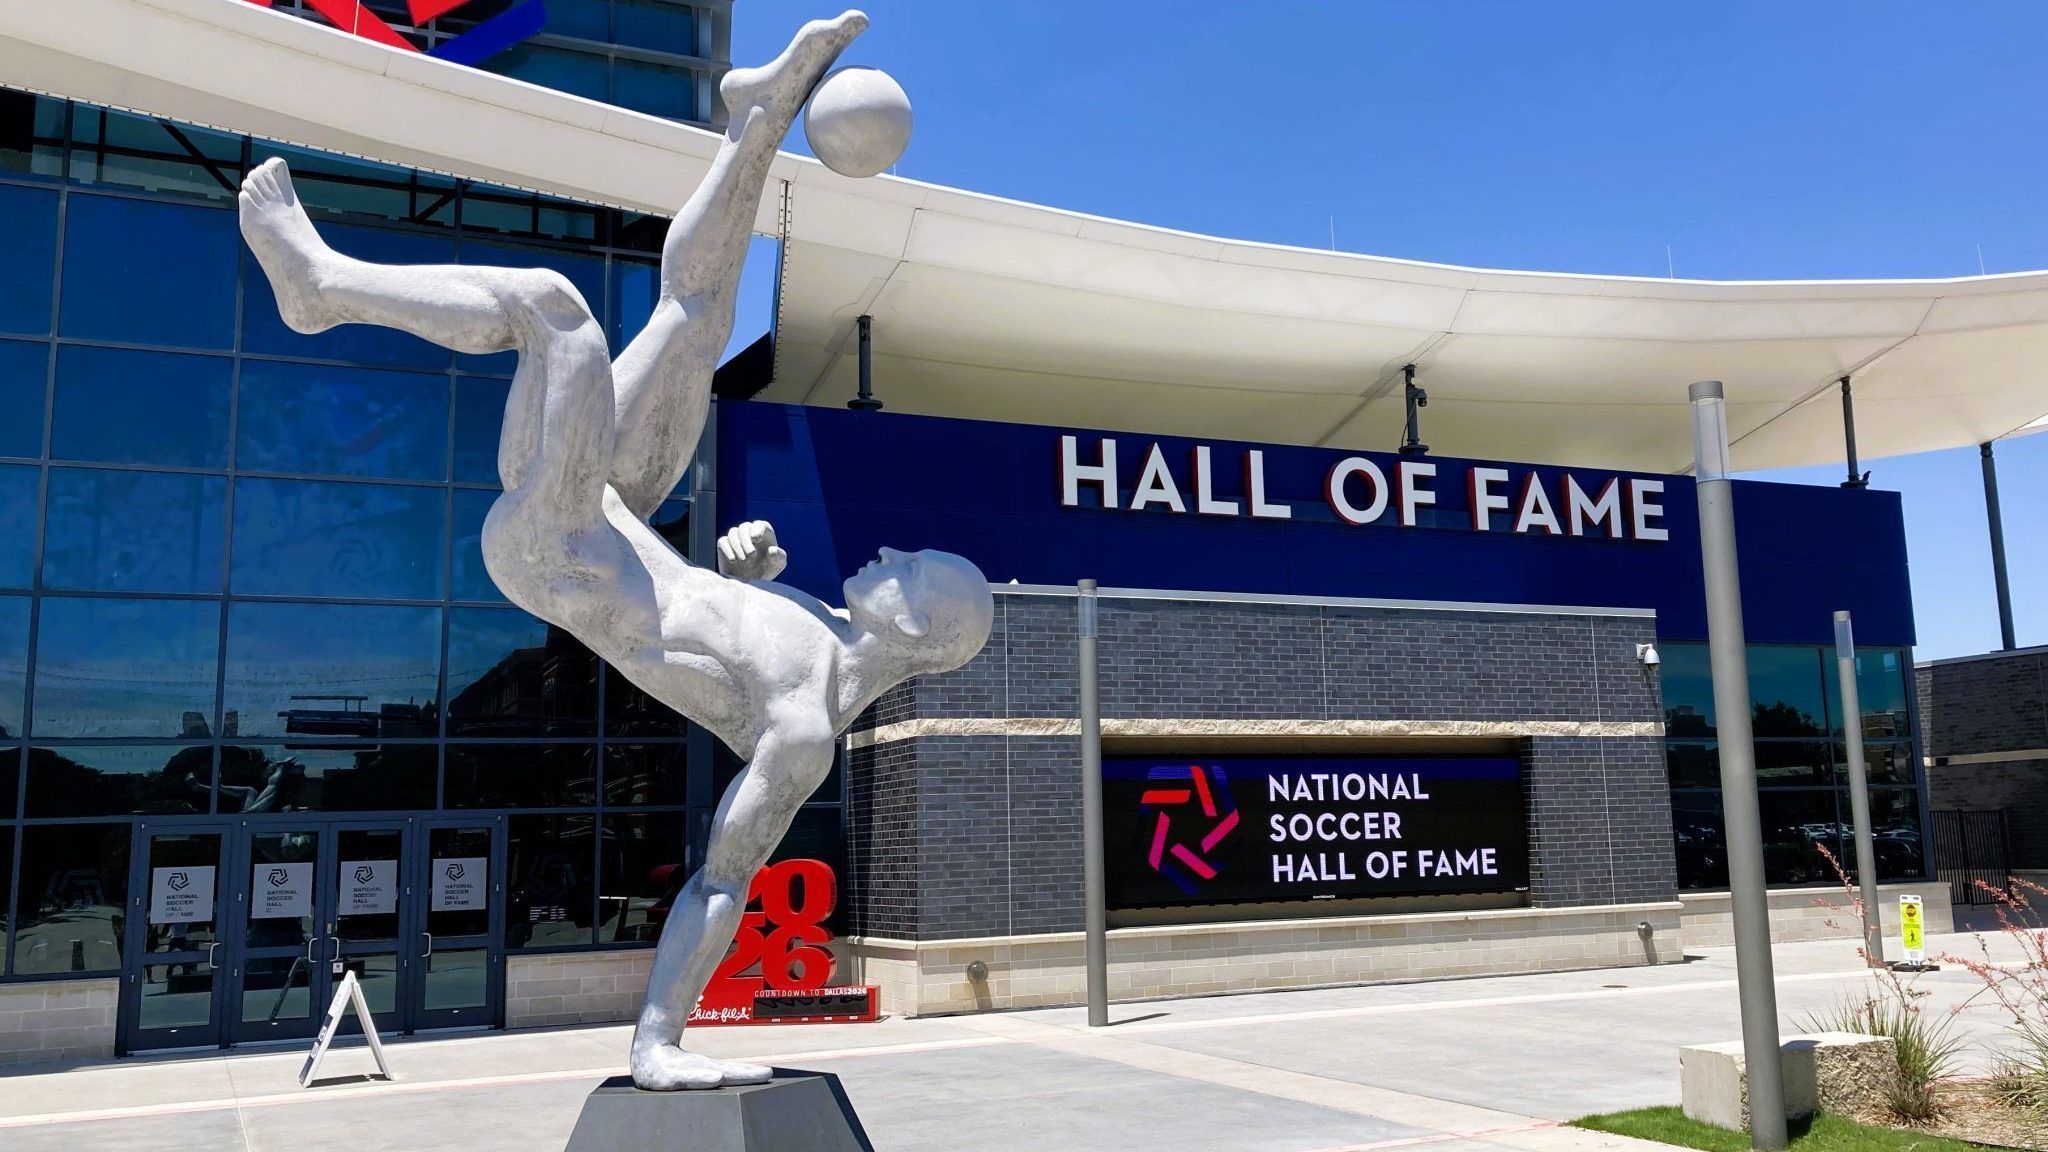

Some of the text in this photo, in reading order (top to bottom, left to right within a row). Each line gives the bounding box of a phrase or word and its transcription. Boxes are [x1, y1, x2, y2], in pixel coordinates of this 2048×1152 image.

[1058, 435, 1670, 542] HALL OF FAME
[1268, 772, 1430, 802] NATIONAL
[1269, 811, 1403, 843] SOCCER
[1272, 847, 1499, 883] HALL OF FAME
[754, 989, 806, 998] COUNTDOWN
[824, 987, 867, 995] DALLAS2026
